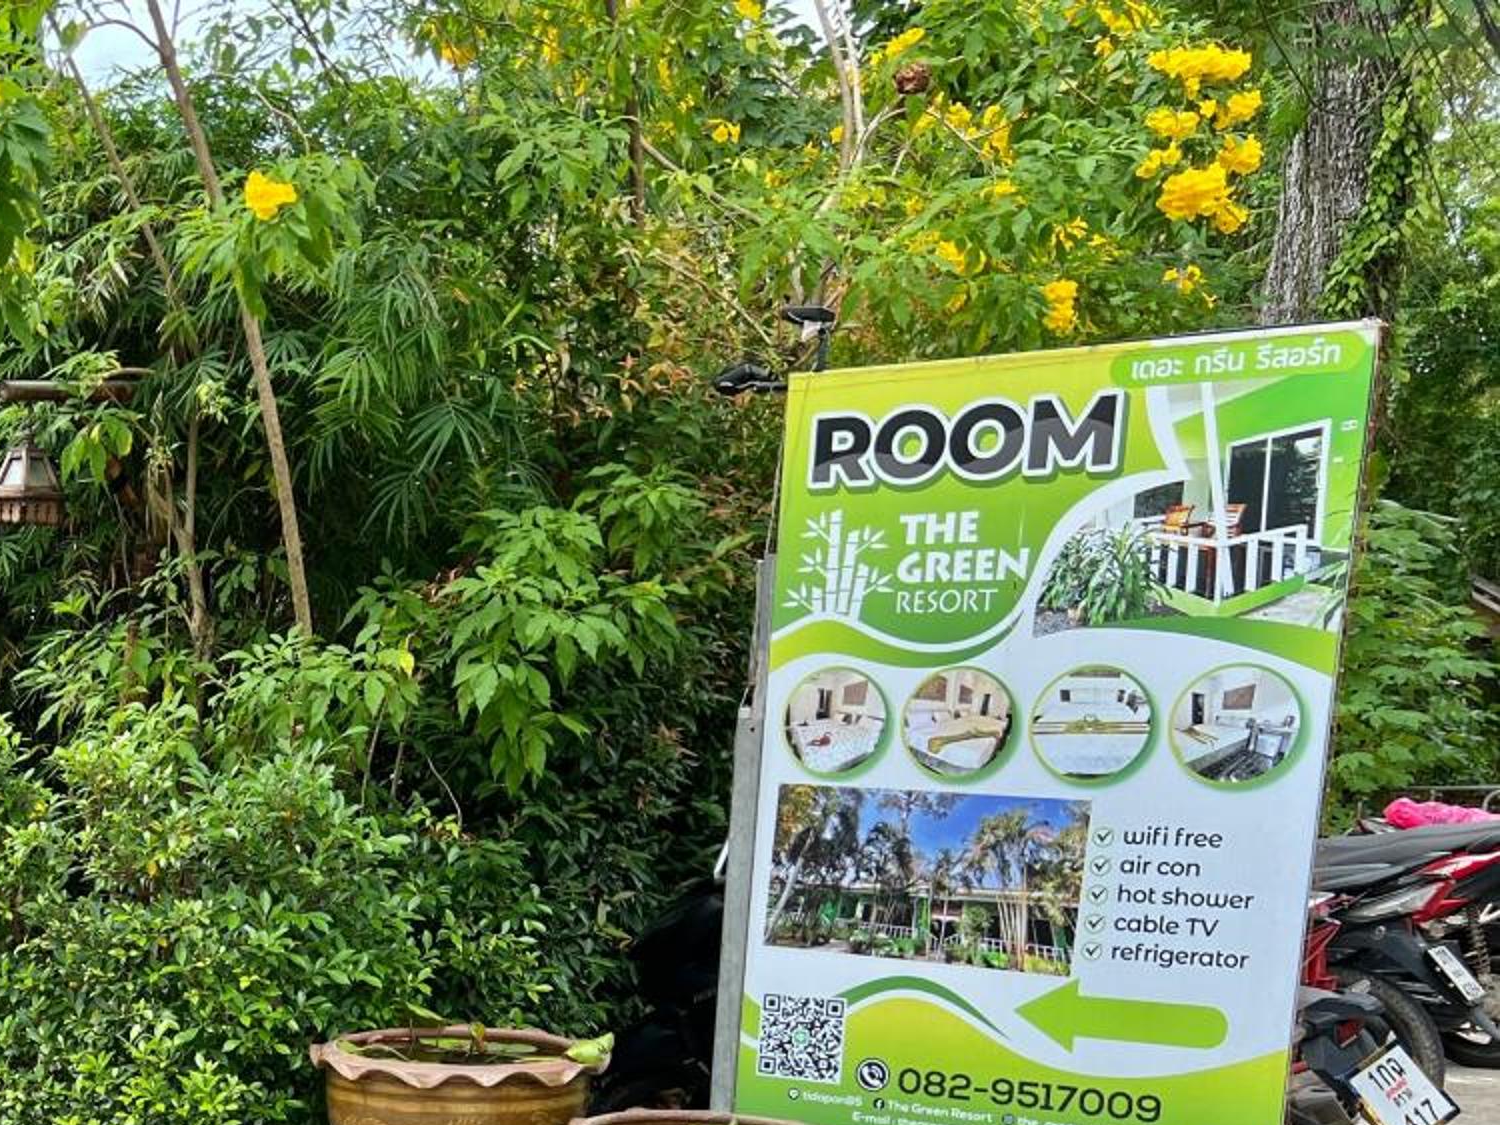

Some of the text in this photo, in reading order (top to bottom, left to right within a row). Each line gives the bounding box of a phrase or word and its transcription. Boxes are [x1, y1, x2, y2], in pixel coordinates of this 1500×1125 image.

[1131, 358, 1185, 381] เดอะ
[1194, 347, 1245, 376] กรีน
[809, 390, 1126, 489] ROOM
[900, 510, 980, 545] THE
[896, 547, 1031, 584] GREEN
[895, 588, 999, 614] RESORT
[1123, 825, 1224, 849] wifi free
[1119, 855, 1202, 877] air con
[1116, 883, 1255, 910] hot shower
[1113, 913, 1220, 937] cable TV
[1110, 942, 1250, 969] refrigerator
[898, 1067, 1162, 1123] 082-9517009
[851, 1110, 891, 1125] E-mail
[888, 1099, 993, 1123] The Green Resort
